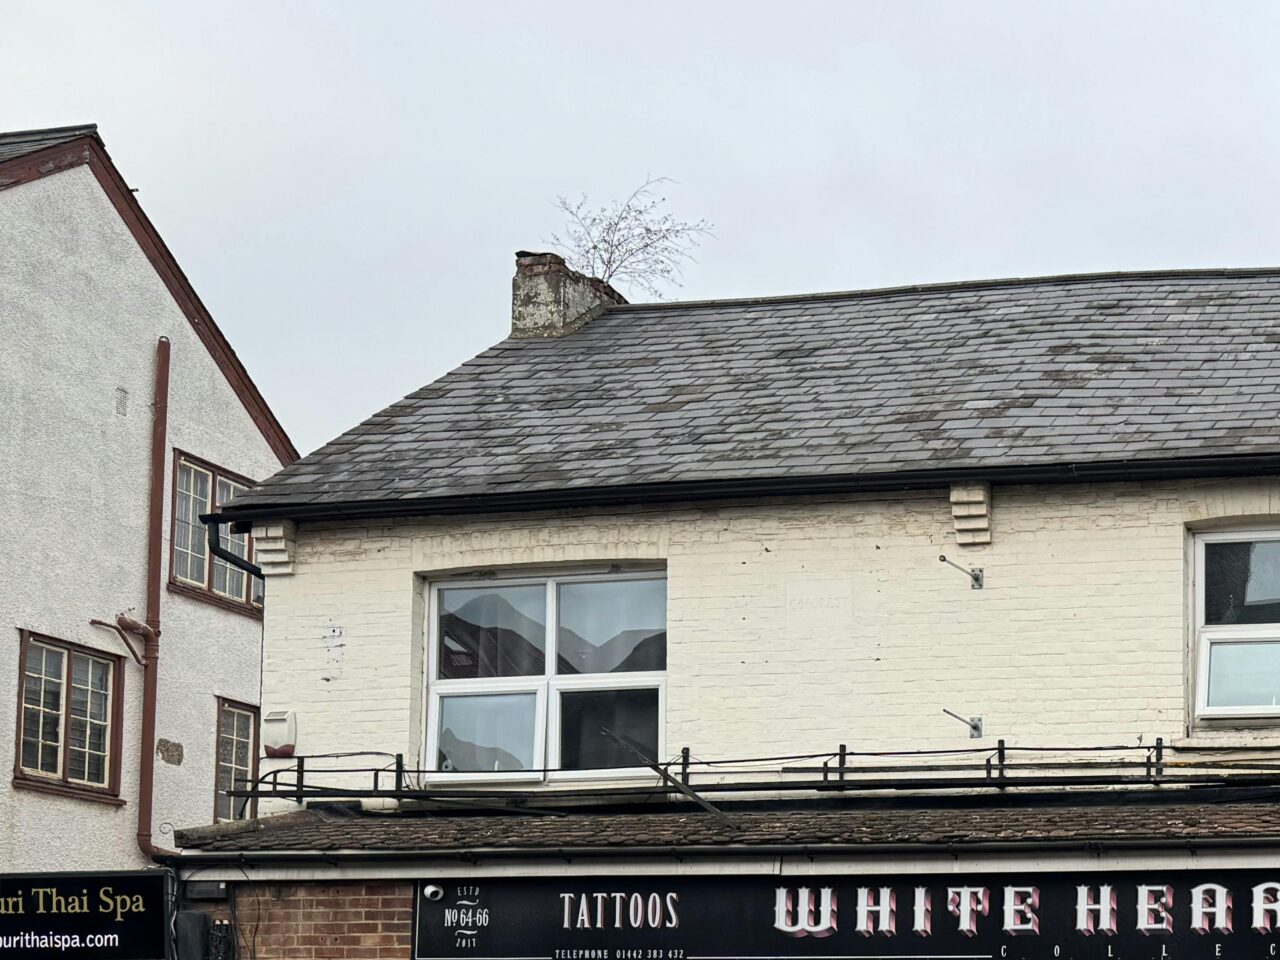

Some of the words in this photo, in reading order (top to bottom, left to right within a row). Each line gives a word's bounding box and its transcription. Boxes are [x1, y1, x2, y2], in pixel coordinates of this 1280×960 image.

[31, 887, 90, 913] Thai
[99, 887, 146, 921] Spa
[459, 908, 489, 927] 64-66
[559, 892, 679, 930] TATTOOS
[773, 884, 1040, 937] WHITE
[555, 949, 609, 959] TELEPHONE
[616, 949, 643, 959] 01442
[668, 949, 684, 959] 432
